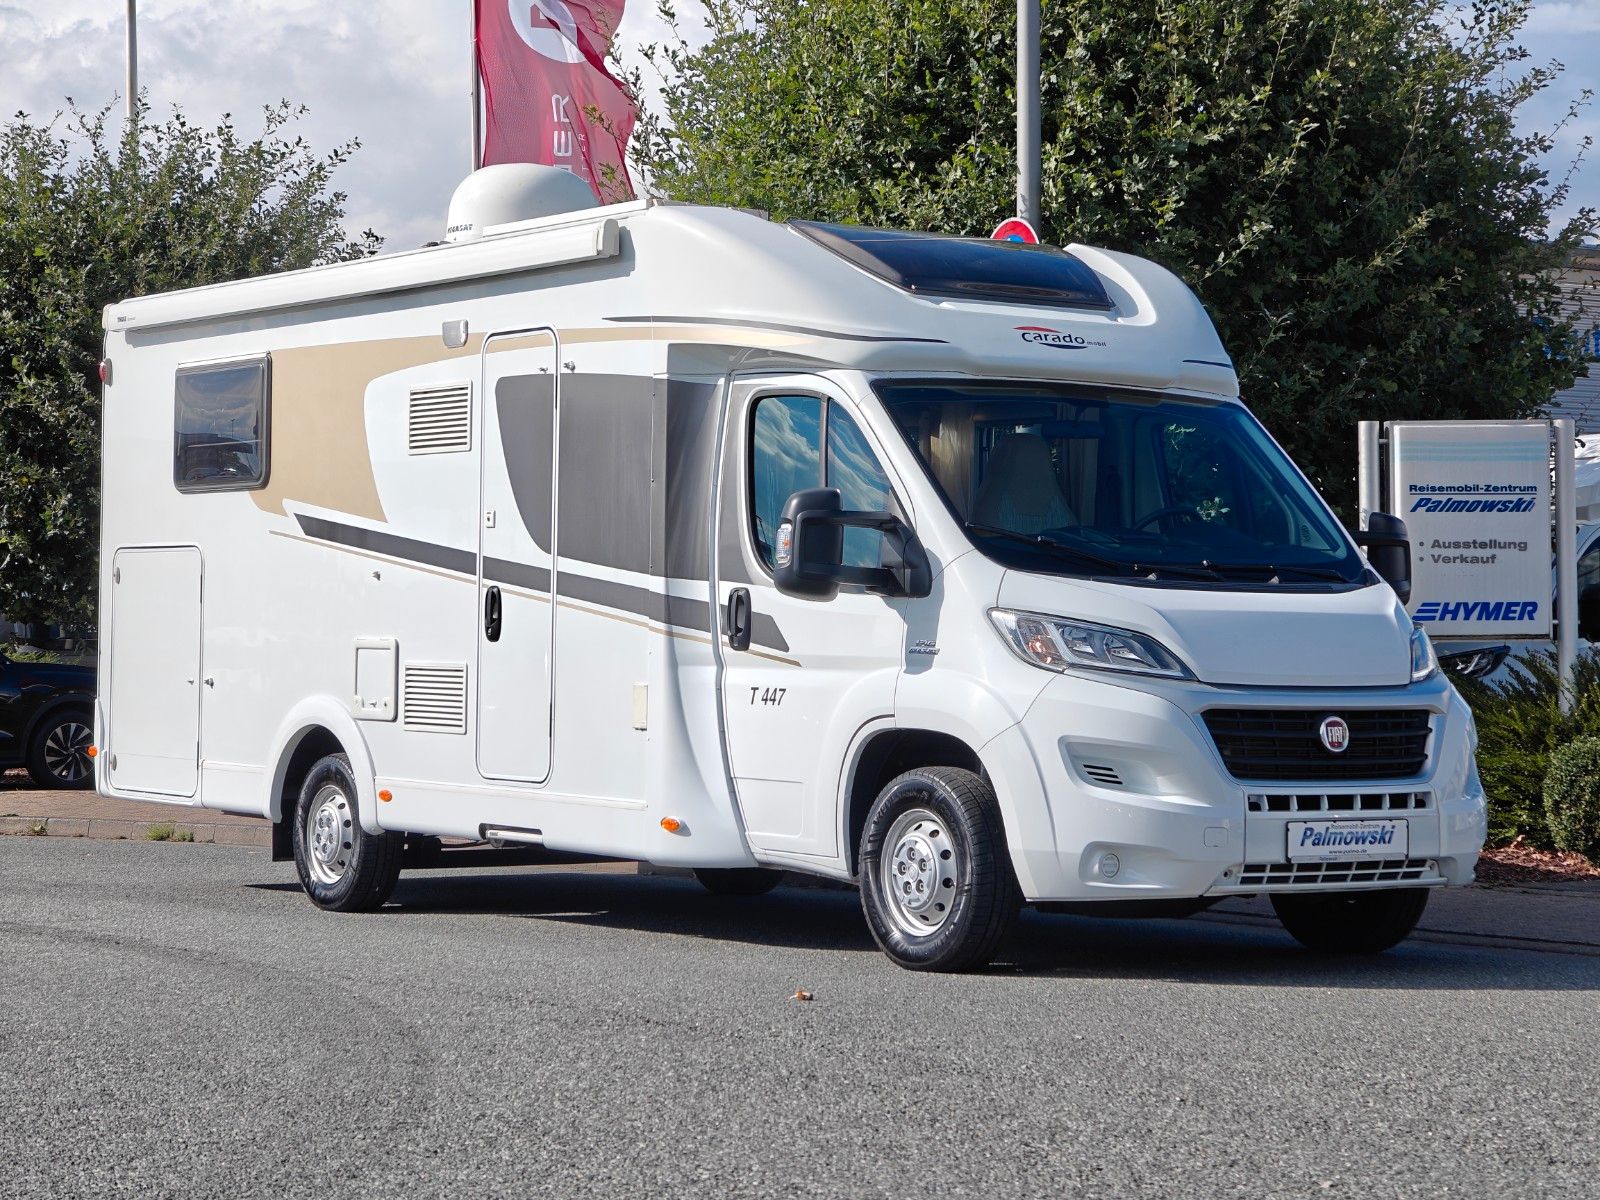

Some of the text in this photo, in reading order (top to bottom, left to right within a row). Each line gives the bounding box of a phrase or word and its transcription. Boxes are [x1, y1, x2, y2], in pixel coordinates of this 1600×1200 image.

[1021, 332, 1085, 345] carado
[1409, 484, 1537, 493] Reisemobil-Zentrum
[1409, 497, 1537, 513] Palmowski
[1430, 539, 1528, 552] Ausstellung
[1430, 554, 1497, 565] Verkauf
[1438, 601, 1539, 622] HYMER
[750, 686, 787, 706] T 447
[1327, 726, 1344, 743] FIAT
[1300, 825, 1396, 847] Palmowski
